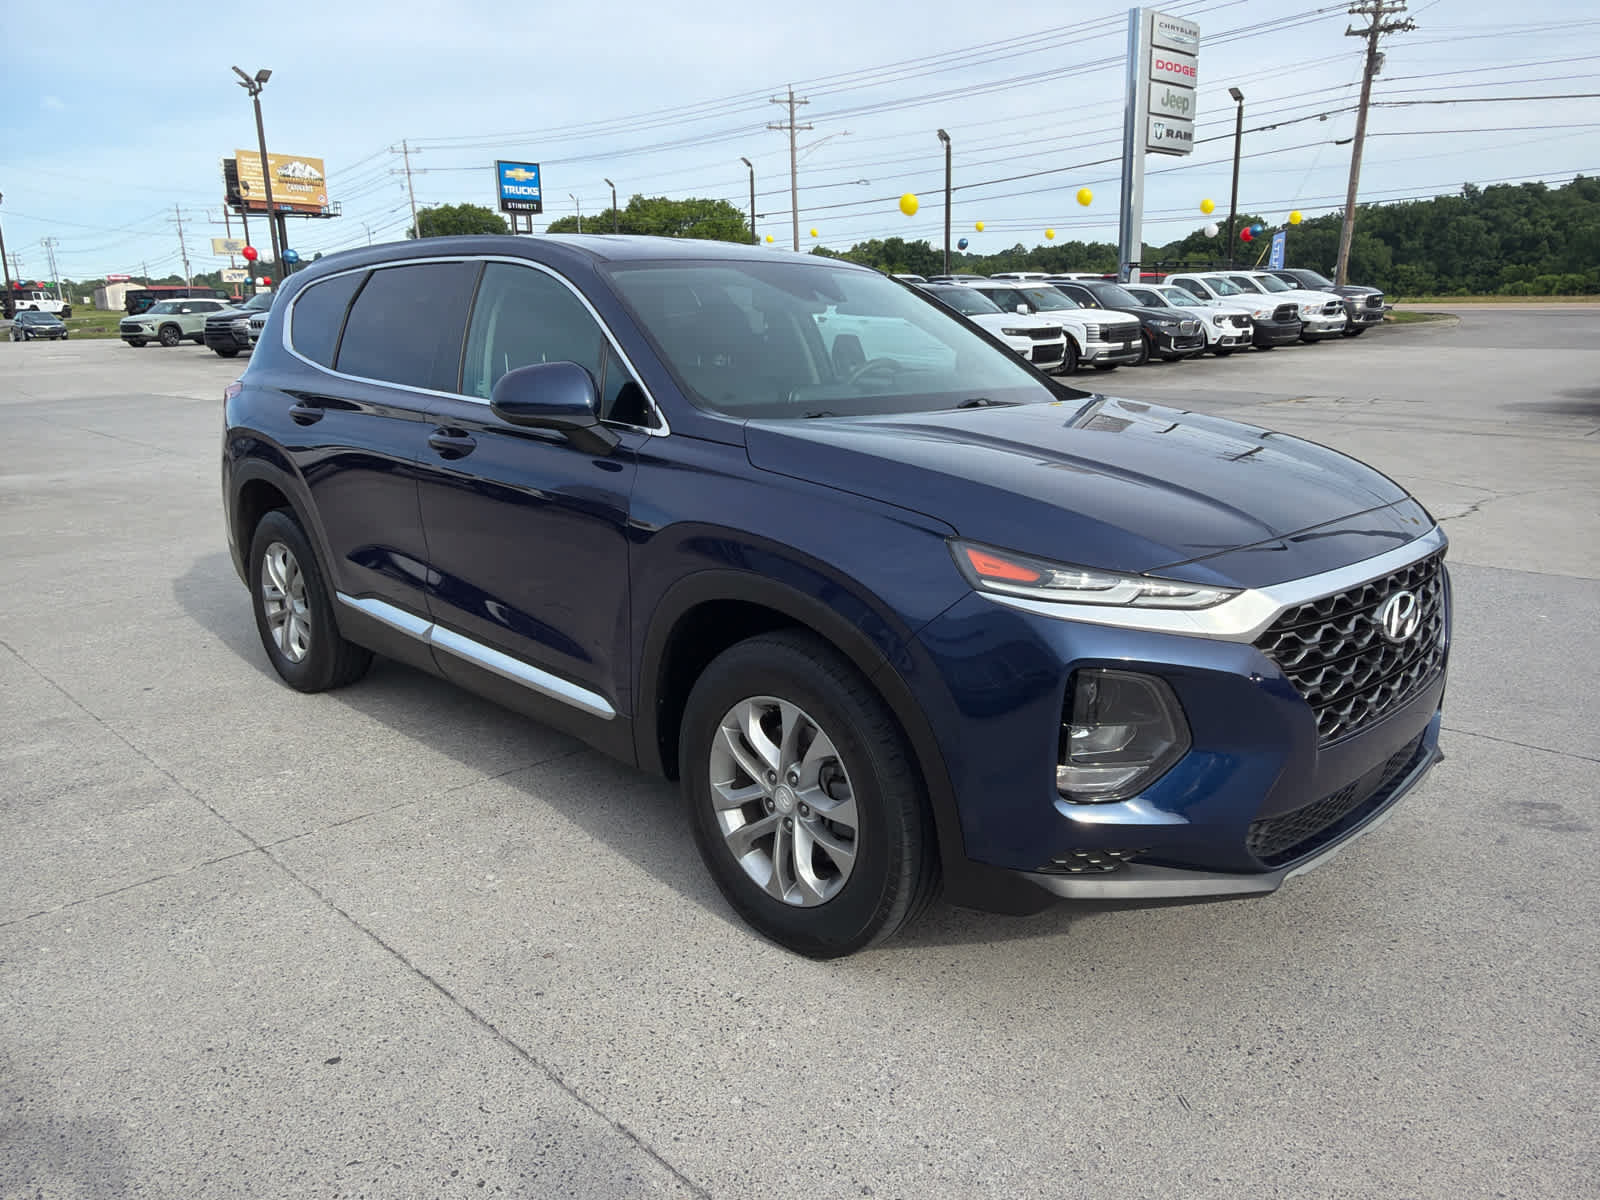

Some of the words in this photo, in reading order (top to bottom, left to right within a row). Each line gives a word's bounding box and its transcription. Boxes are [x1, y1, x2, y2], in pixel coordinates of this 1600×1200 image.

[1158, 21, 1198, 37] CHRYSLER
[1155, 59, 1196, 78] DODGE
[1161, 88, 1190, 114] Jeep
[1165, 127, 1193, 142] RAM
[503, 185, 539, 196] TRUCKS
[507, 202, 537, 210] STINNETT
